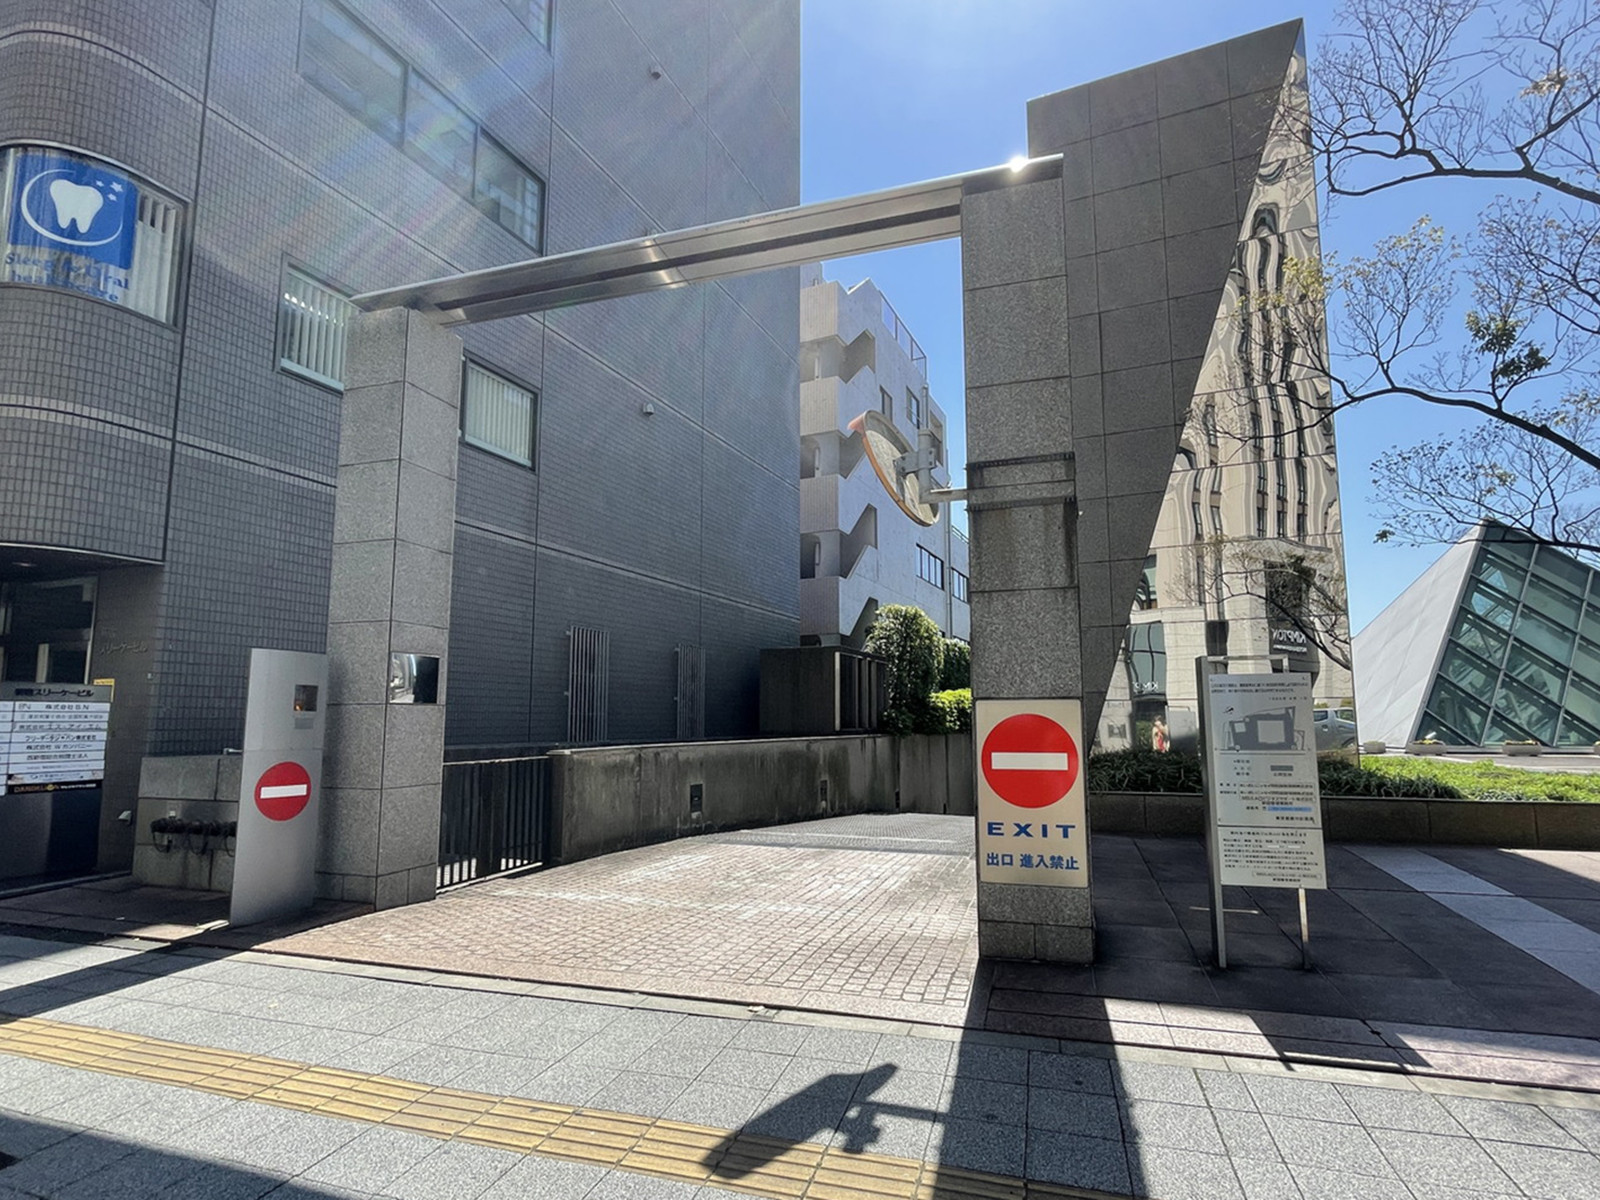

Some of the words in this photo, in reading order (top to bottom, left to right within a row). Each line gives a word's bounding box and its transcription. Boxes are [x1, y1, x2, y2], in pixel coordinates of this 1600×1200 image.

[987, 822, 1076, 838] EXIT
[986, 852, 1014, 866] 出口
[1020, 853, 1080, 870] 進入禁止
